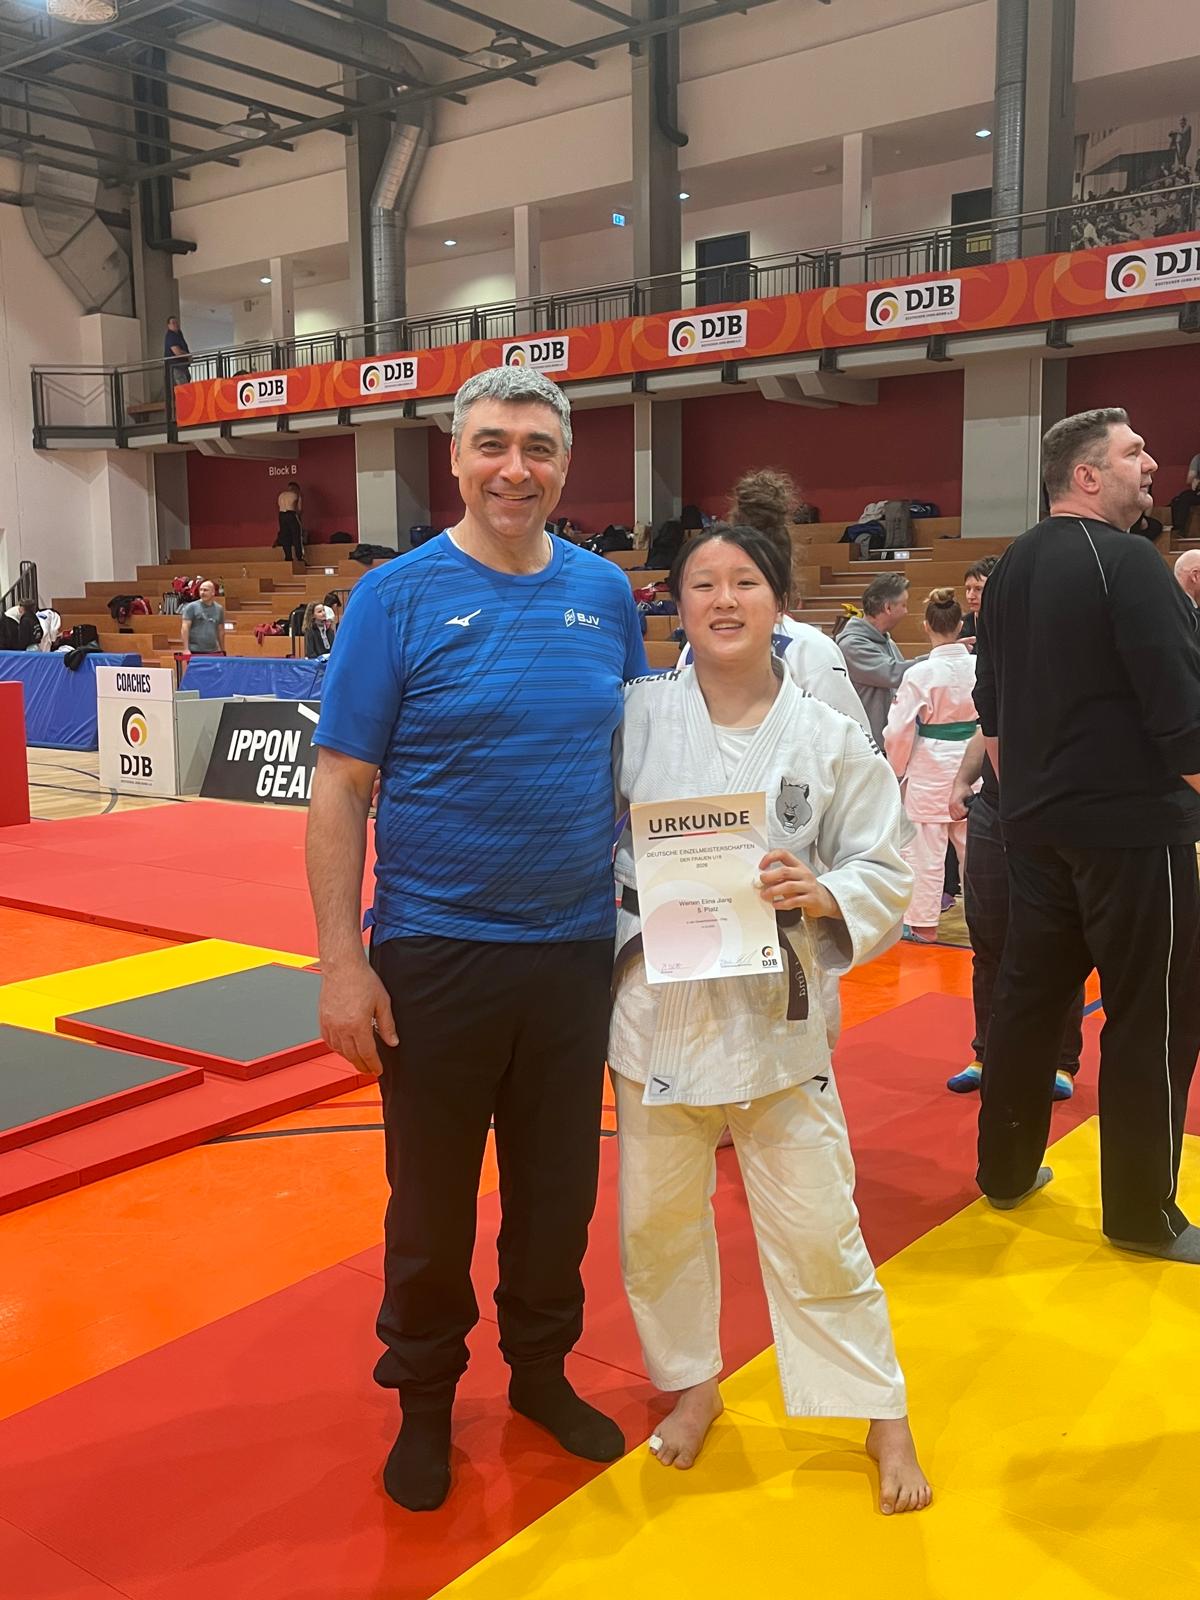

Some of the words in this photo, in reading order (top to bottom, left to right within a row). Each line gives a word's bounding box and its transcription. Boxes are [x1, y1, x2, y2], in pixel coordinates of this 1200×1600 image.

[1154, 247, 1200, 276] DJ
[904, 285, 955, 311] DJB
[701, 315, 742, 339] DJB
[529, 341, 565, 362] DJB
[383, 361, 414, 381] DJB
[258, 379, 284, 397] DJB
[269, 465, 290, 476] Block
[291, 464, 297, 475] B
[576, 612, 600, 626] BJV
[116, 673, 151, 693] COACHES
[227, 729, 302, 763] IPPON
[119, 754, 153, 777] DJB
[649, 810, 750, 833] URKUNDE
[646, 850, 679, 858] DEUTSCHE
[680, 843, 755, 855] EINZELMEISTERSCHAFTEN
[762, 959, 778, 967] DJB
